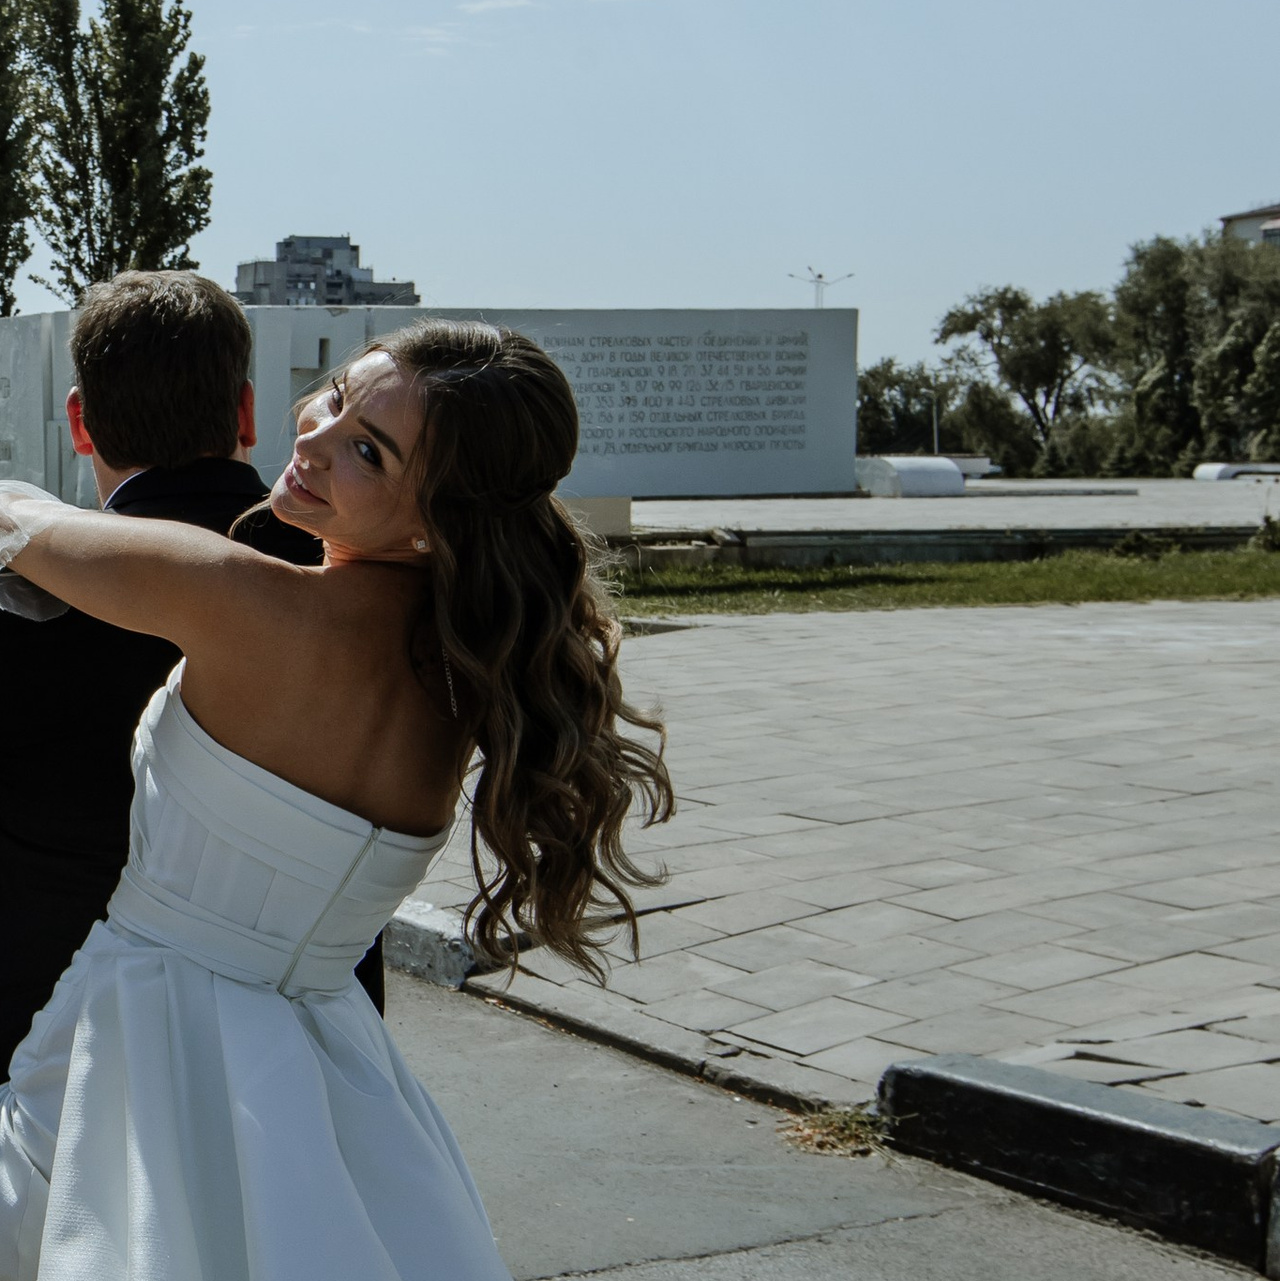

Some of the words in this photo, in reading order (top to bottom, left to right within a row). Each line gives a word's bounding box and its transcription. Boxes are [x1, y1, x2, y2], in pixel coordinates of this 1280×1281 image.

[589, 336, 652, 347] СТРЕЛКОВЫХ
[580, 351, 606, 363] ДОНУ
[609, 351, 616, 363] В
[620, 351, 645, 363] ГОДЫ
[575, 366, 582, 378] 2
[657, 365, 664, 377] 9
[635, 381, 648, 393] 87
[651, 381, 665, 393] 96
[669, 380, 682, 392] 99
[618, 396, 638, 408] 395
[642, 396, 663, 408] 400
[700, 395, 761, 408] СТРЕЛКОВЫХ
[706, 410, 767, 422] СТРЕЛКОВЫХ
[771, 410, 806, 421] БРИГАД
[629, 426, 694, 438] РОСТОВСКОГО
[697, 425, 751, 437] НАРОДНОГО
[676, 441, 718, 453] БРИГАДЫ
